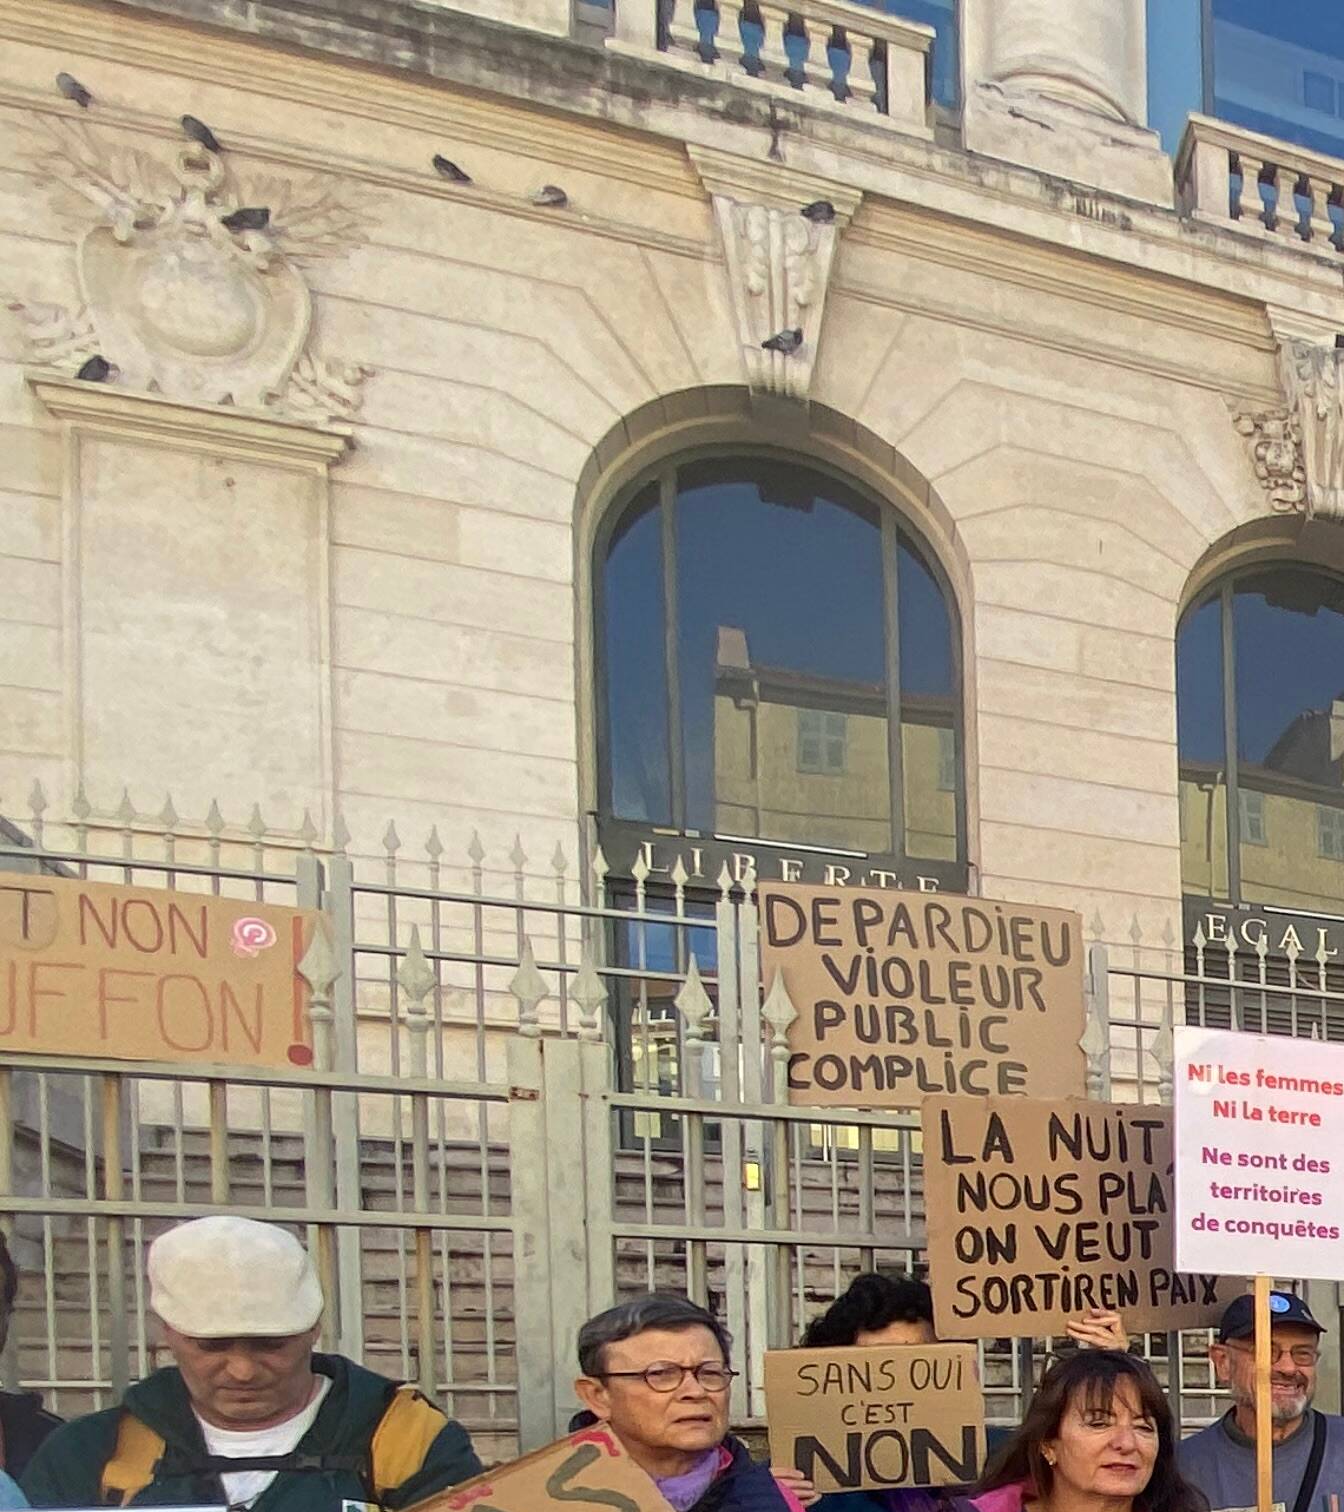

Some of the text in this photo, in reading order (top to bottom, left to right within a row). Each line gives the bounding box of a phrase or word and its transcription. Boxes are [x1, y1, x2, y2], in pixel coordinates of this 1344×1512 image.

[79, 893, 207, 959] NON
[766, 894, 1070, 967] DEPARDIEU
[822, 947, 1046, 1012] VIOLEUR
[814, 1000, 1009, 1053] PUBLIC
[1188, 1064, 1344, 1096] Ni les femmes
[1213, 1100, 1321, 1126] Ni la terre
[941, 1109, 1164, 1165] LA NUIT
[1202, 1147, 1330, 1173] Ne sont des
[958, 1171, 1083, 1215] NOUS
[1210, 1182, 1322, 1205] territoires
[955, 1221, 1159, 1264] ON VEUT
[1191, 1213, 1340, 1240] de conquêtes
[797, 1355, 963, 1396] SANS OUI
[841, 1400, 915, 1426] C'EST
[795, 1425, 978, 1488] NON
